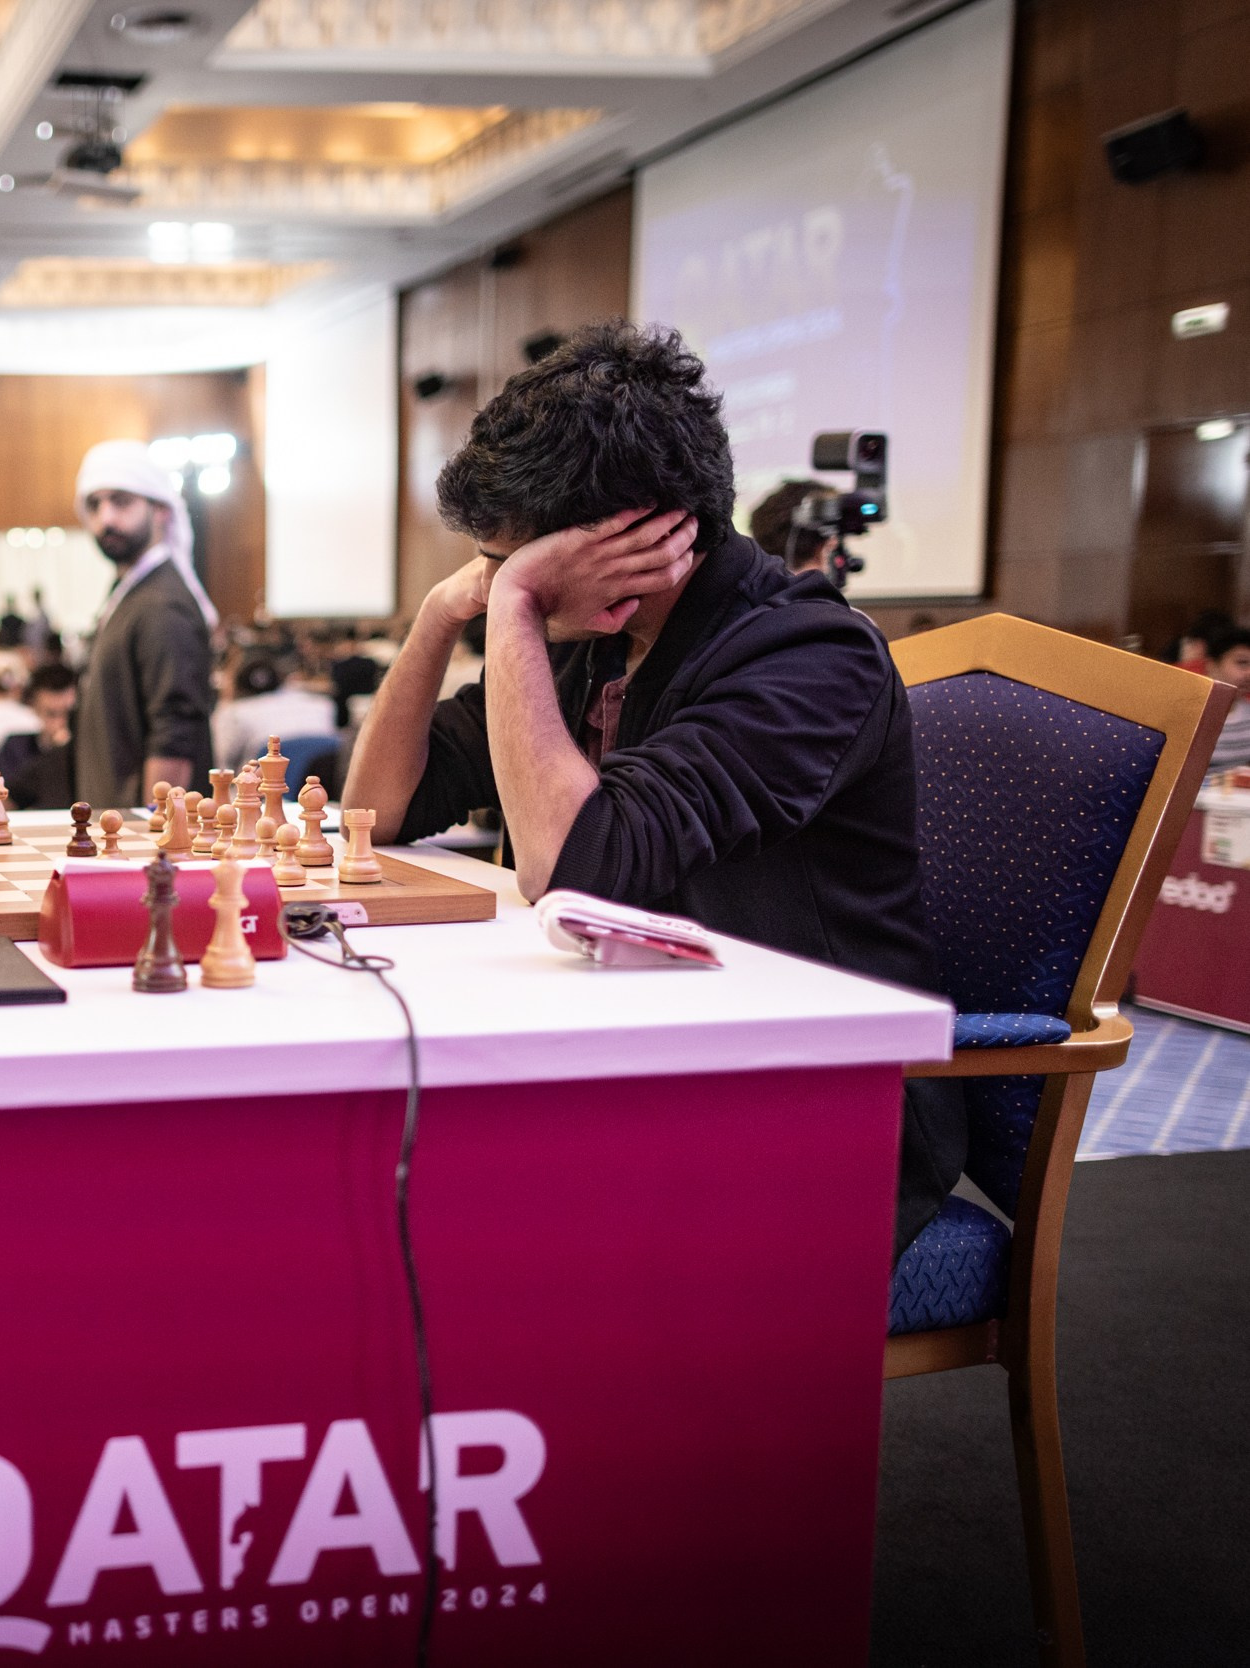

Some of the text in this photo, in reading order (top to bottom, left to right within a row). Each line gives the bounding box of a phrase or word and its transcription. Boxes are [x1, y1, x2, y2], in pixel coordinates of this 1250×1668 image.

[240, 915, 259, 933] GT
[69, 1582, 547, 1645] MASTERS OPEN 2024
